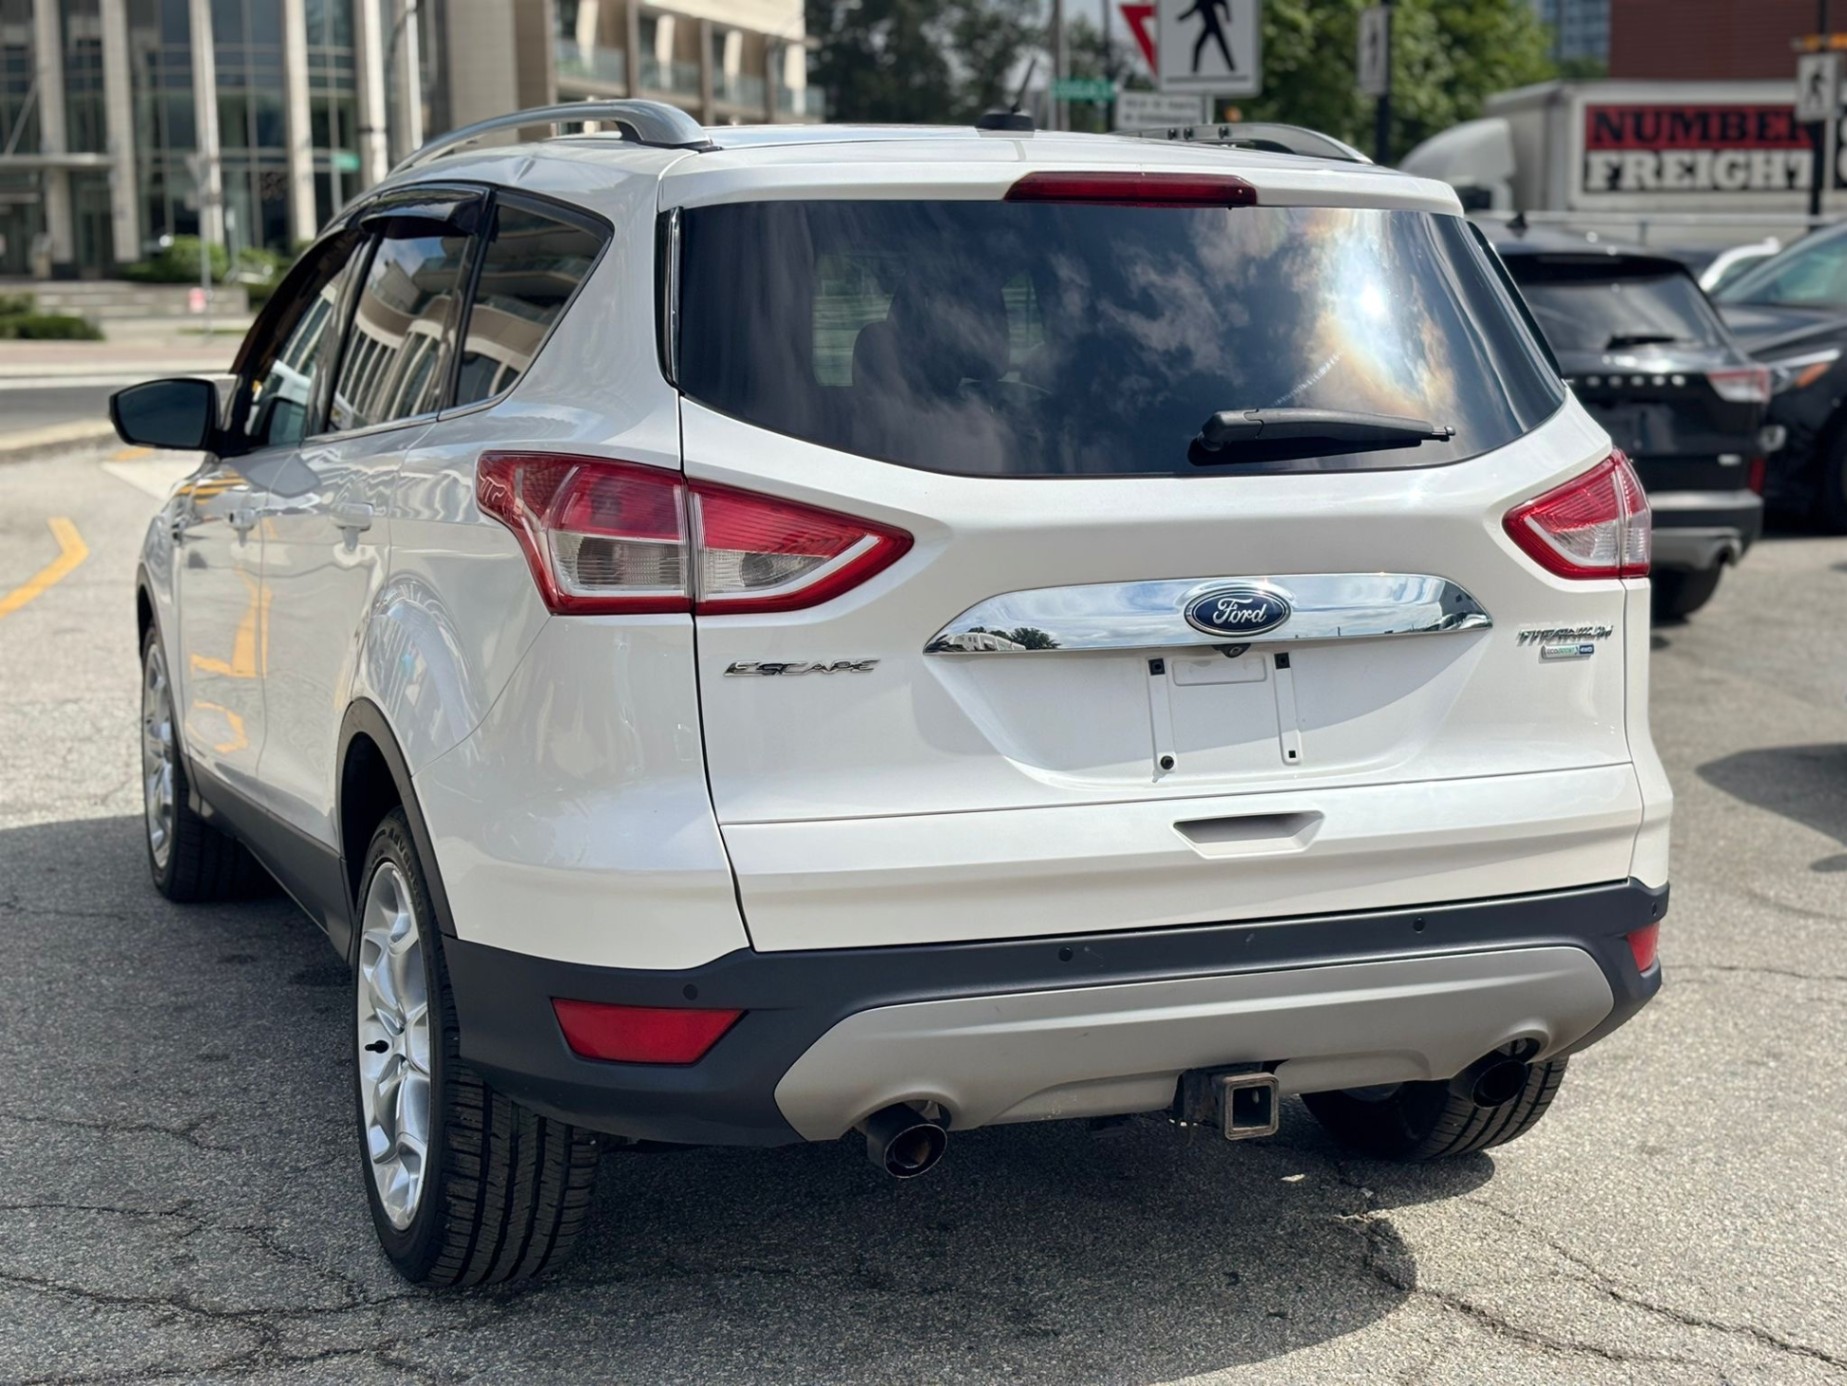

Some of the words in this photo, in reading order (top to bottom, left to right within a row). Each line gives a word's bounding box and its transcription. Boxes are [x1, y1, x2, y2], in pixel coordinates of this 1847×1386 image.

[1587, 148, 1814, 189] FREIGHT
[1212, 597, 1268, 625] Ford
[723, 658, 882, 678] ESCAPE
